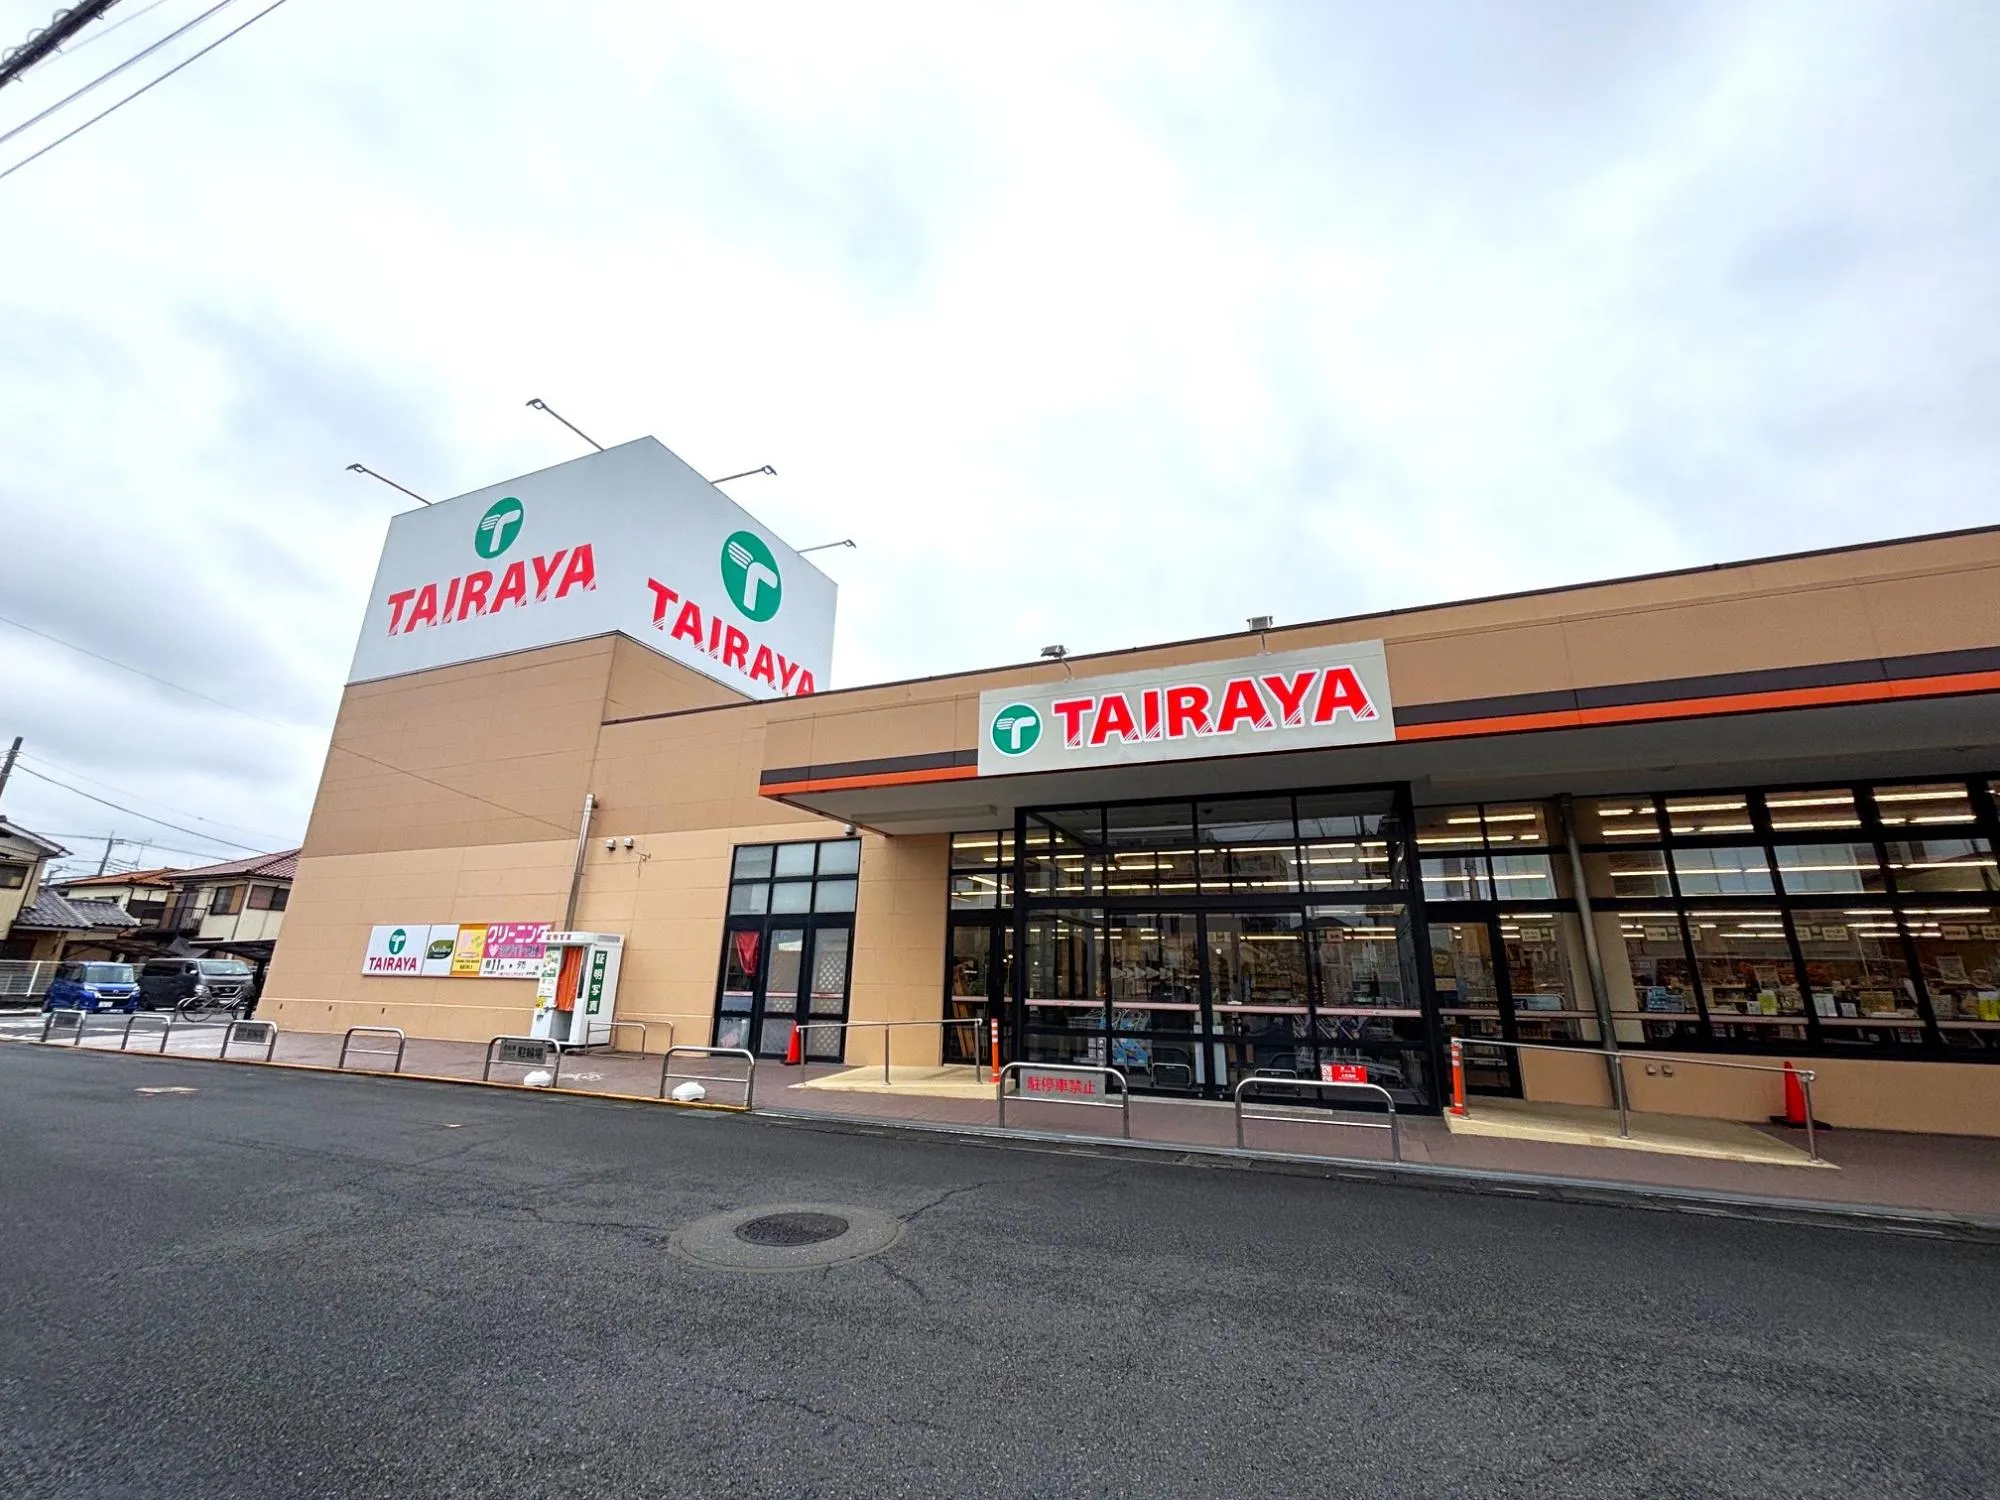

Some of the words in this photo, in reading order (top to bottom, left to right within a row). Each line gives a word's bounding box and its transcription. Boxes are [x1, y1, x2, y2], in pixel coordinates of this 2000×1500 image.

[388, 543, 596, 635] TAIRAYA
[1052, 664, 1376, 748] TAIRAYA
[369, 957, 417, 971] TAIRAYA
[588, 952, 607, 1012] 証明写真
[1026, 1074, 1096, 1097] 駐停車禁止
